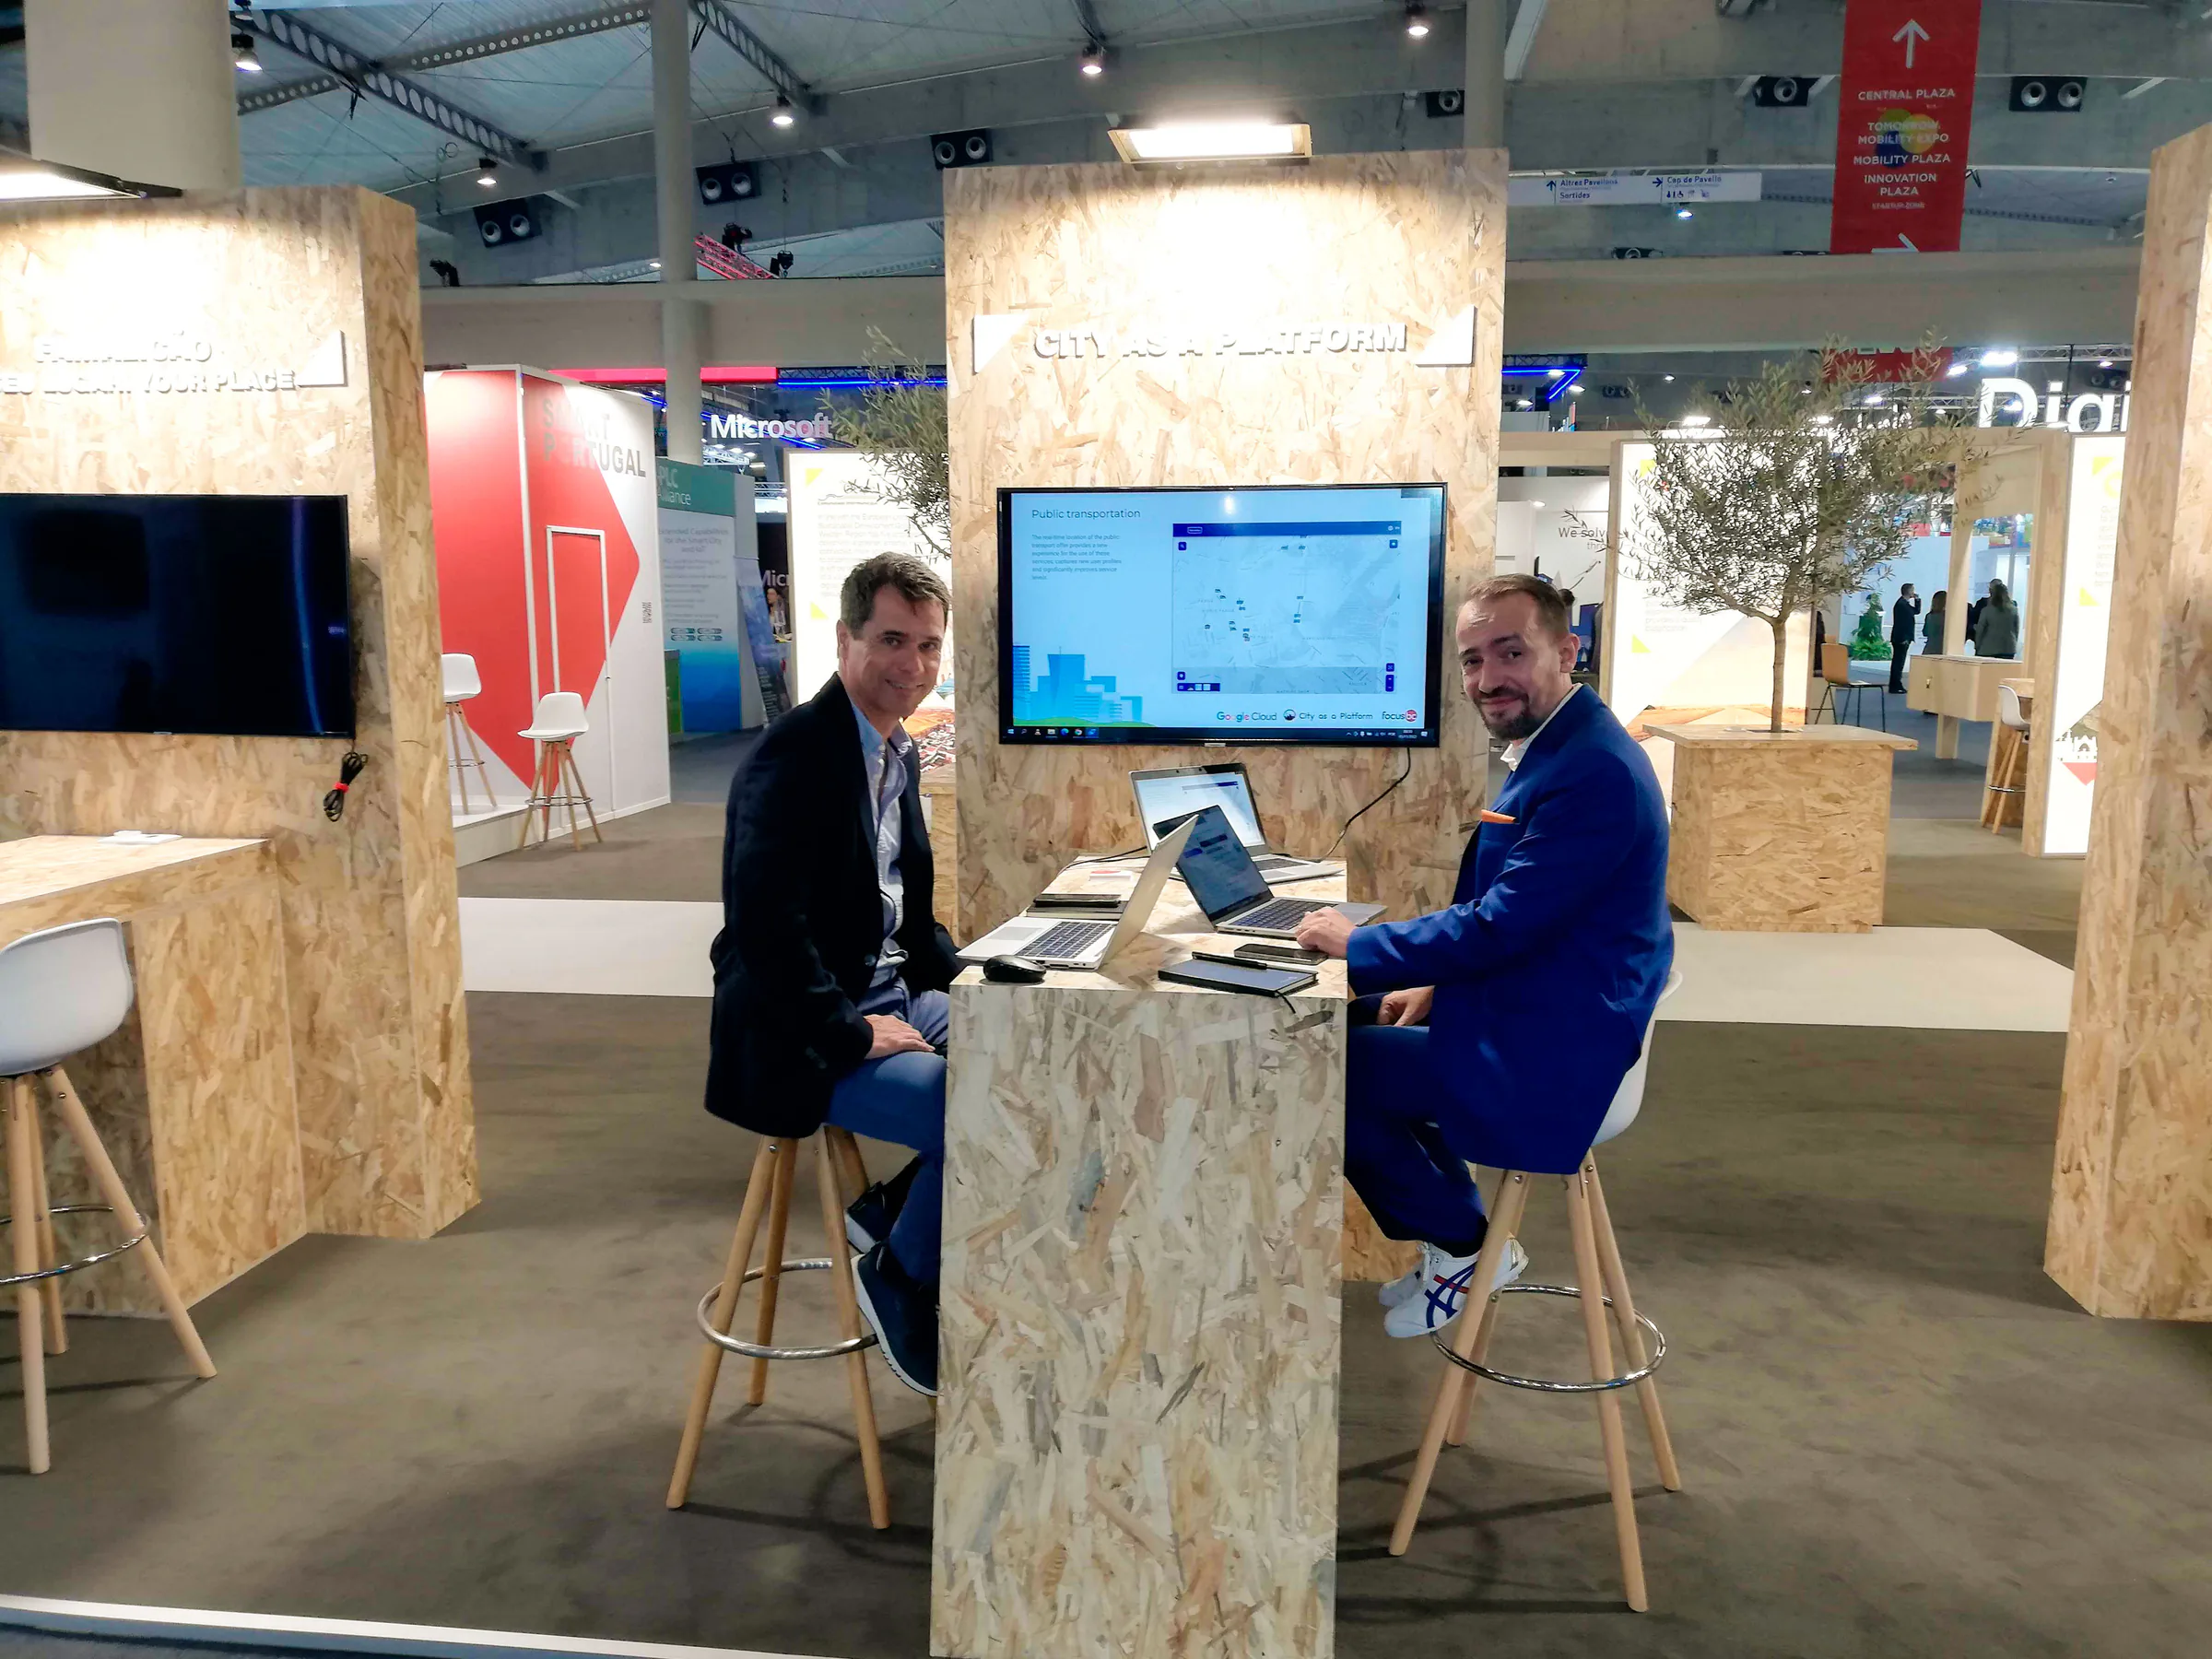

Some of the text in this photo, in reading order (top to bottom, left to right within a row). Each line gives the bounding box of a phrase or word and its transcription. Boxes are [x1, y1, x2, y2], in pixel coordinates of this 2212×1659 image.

[1858, 88, 1956, 100] CENTRAL PLAZA
[1858, 133, 1949, 145] MOBILITY EXPO
[1853, 153, 1951, 165] MOBILITY PLAZA
[1666, 177, 1681, 185] Cap
[1864, 173, 1936, 183] INNOVATION
[1880, 186, 1919, 196] PLAZA
[1034, 323, 1408, 359] CITY AS A PLATFORM
[214, 369, 298, 393] PLACE
[711, 412, 833, 439] Microsoft
[1031, 509, 1141, 520] Public transportation
[1559, 527, 1578, 537] We
[1217, 711, 1250, 723] Google
[1252, 712, 1277, 721] Cloud
[1299, 712, 1314, 722] City
[1339, 712, 1373, 720] Platform
